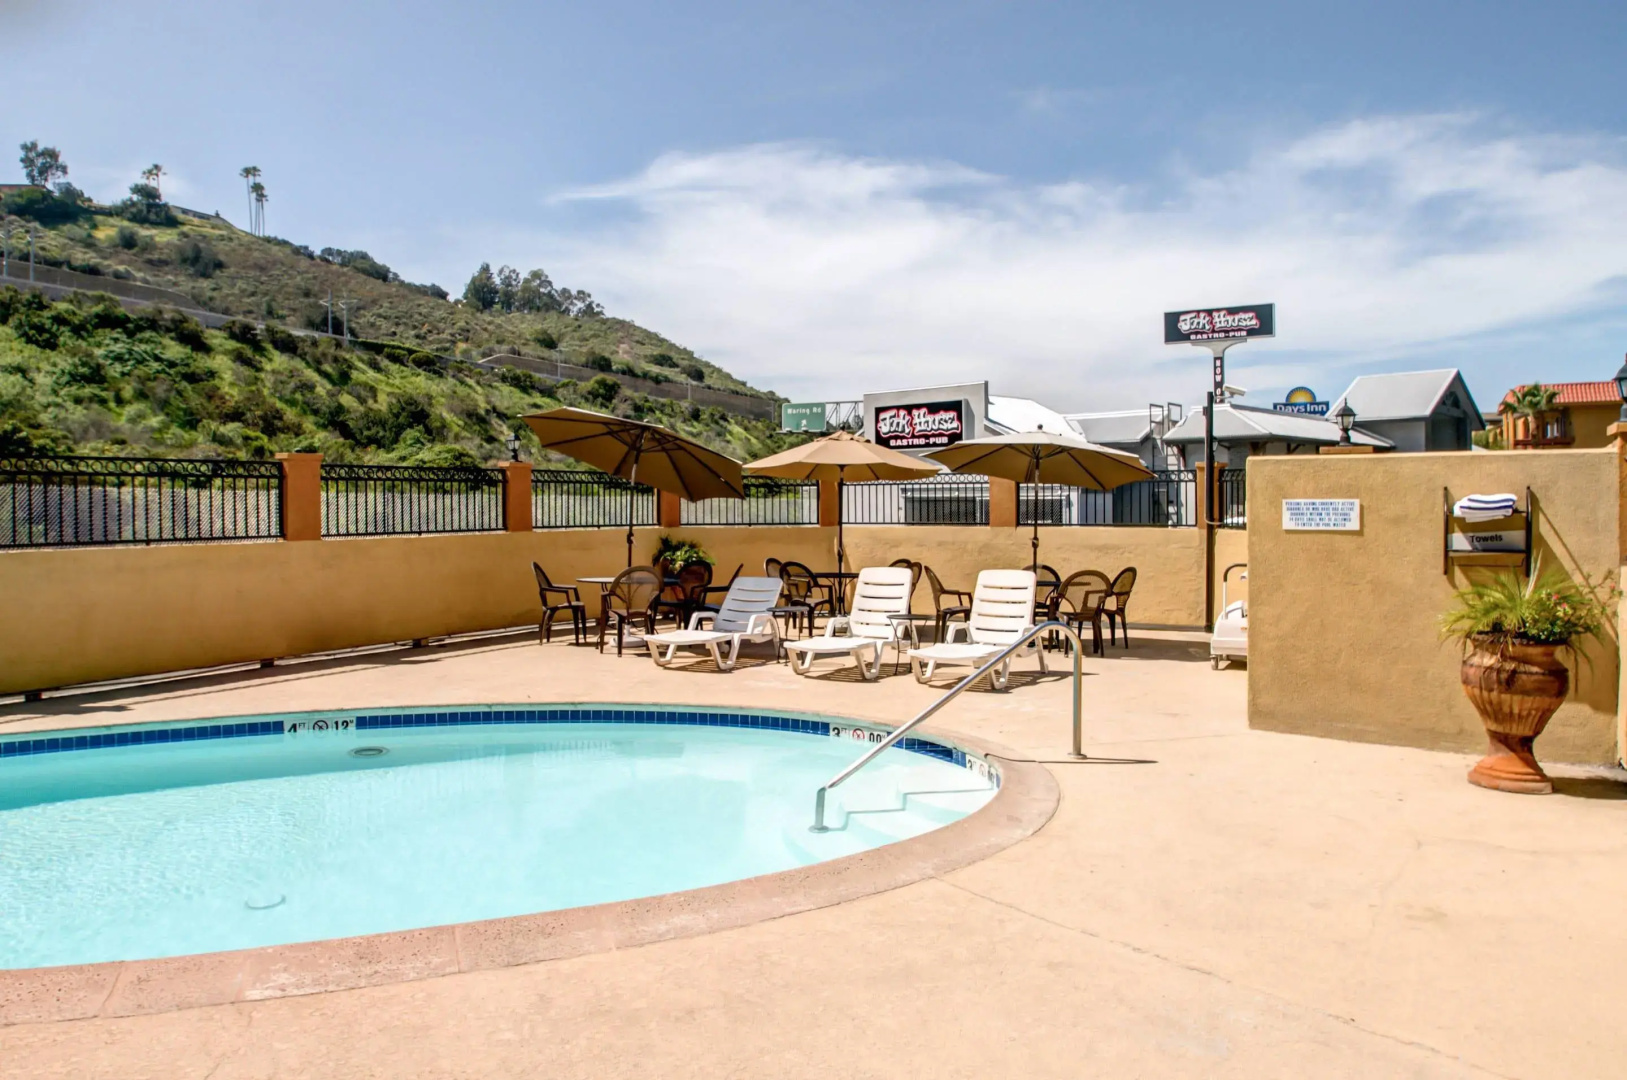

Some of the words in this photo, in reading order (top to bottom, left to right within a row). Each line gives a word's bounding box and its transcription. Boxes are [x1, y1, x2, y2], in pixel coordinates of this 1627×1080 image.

[1190, 331, 1247, 340] GASTRO-PUB
[787, 408, 810, 416] Waring
[889, 436, 949, 446] GASTRO-PUB
[1469, 534, 1503, 543] Towels
